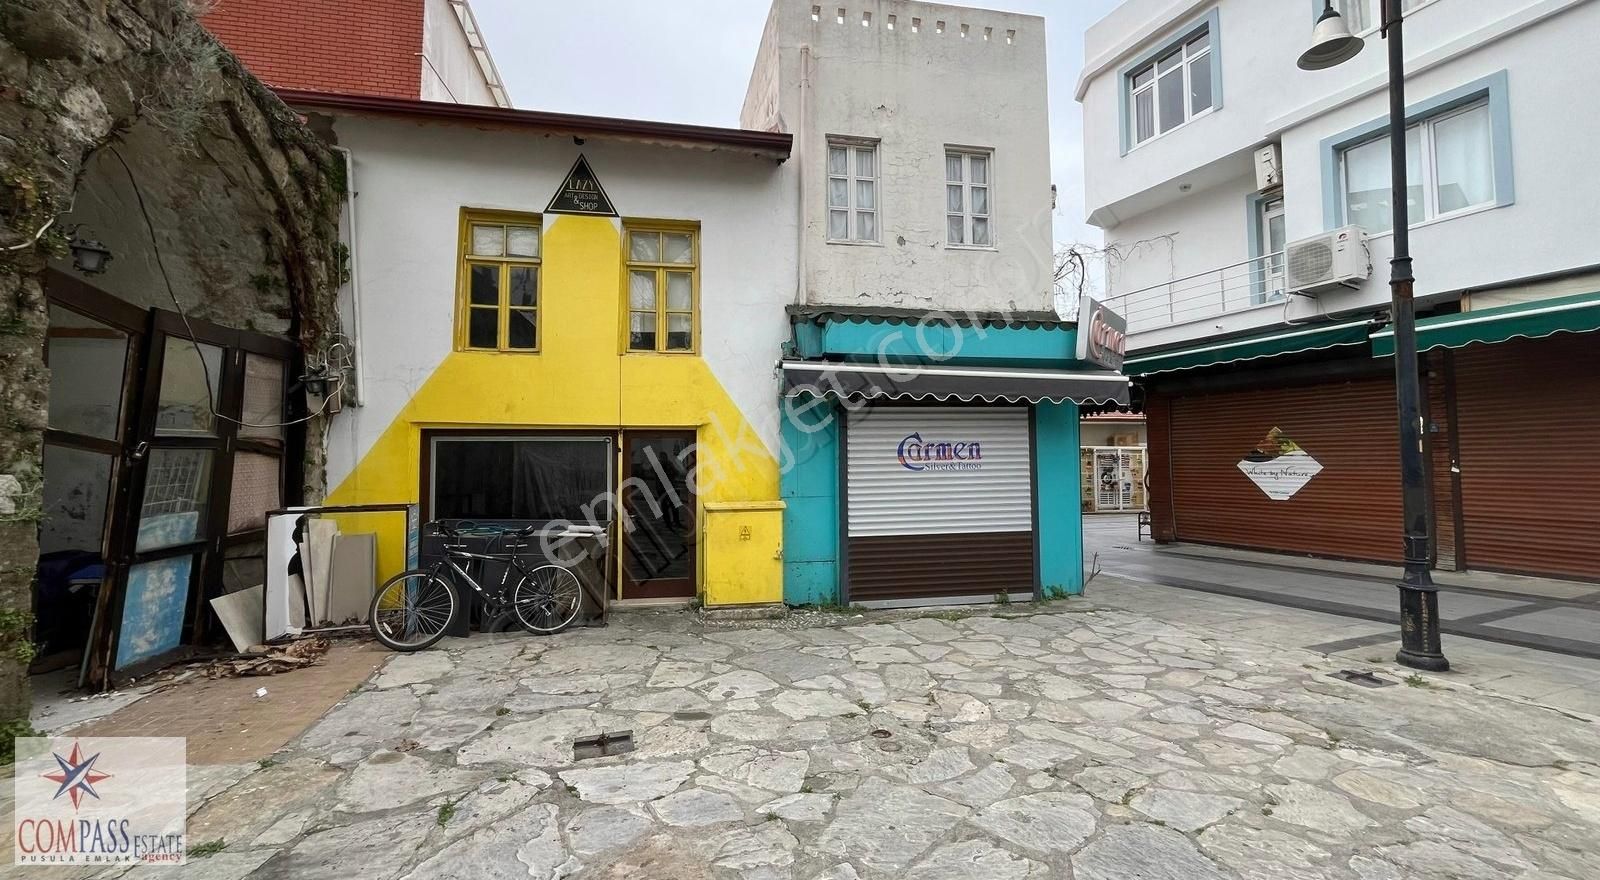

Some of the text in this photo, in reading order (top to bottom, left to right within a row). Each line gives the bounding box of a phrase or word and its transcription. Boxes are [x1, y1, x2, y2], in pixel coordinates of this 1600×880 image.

[573, 195, 599, 210] & SHOP
[897, 432, 982, 471] Carmen
